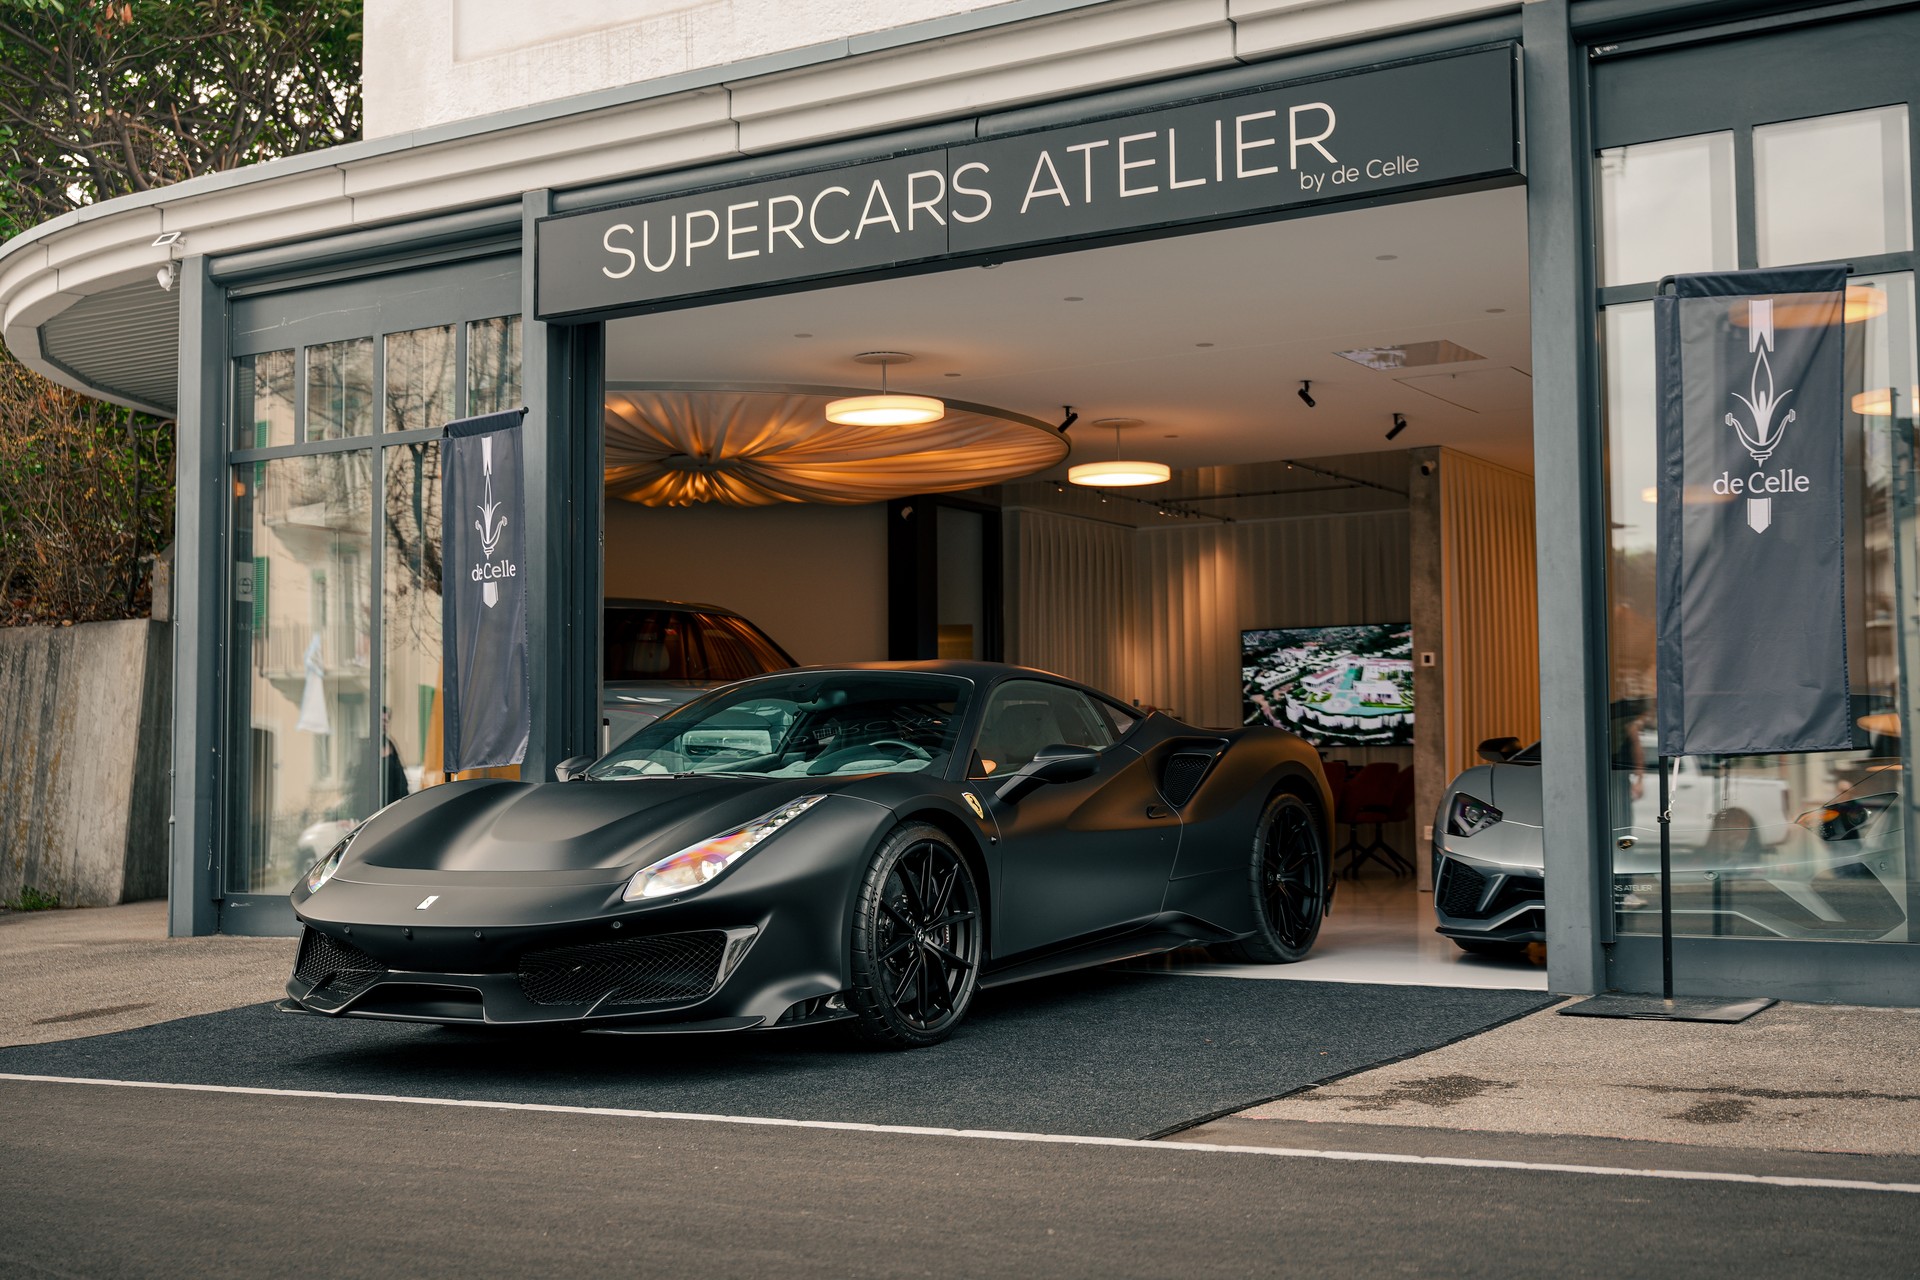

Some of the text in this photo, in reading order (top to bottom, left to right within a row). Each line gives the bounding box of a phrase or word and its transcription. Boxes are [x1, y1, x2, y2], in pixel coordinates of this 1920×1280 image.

[1300, 155, 1420, 193] by de Celle
[602, 102, 1338, 280] SUPERCARS ATELIER
[1712, 468, 1810, 495] de Celle
[471, 560, 516, 581] de Celle
